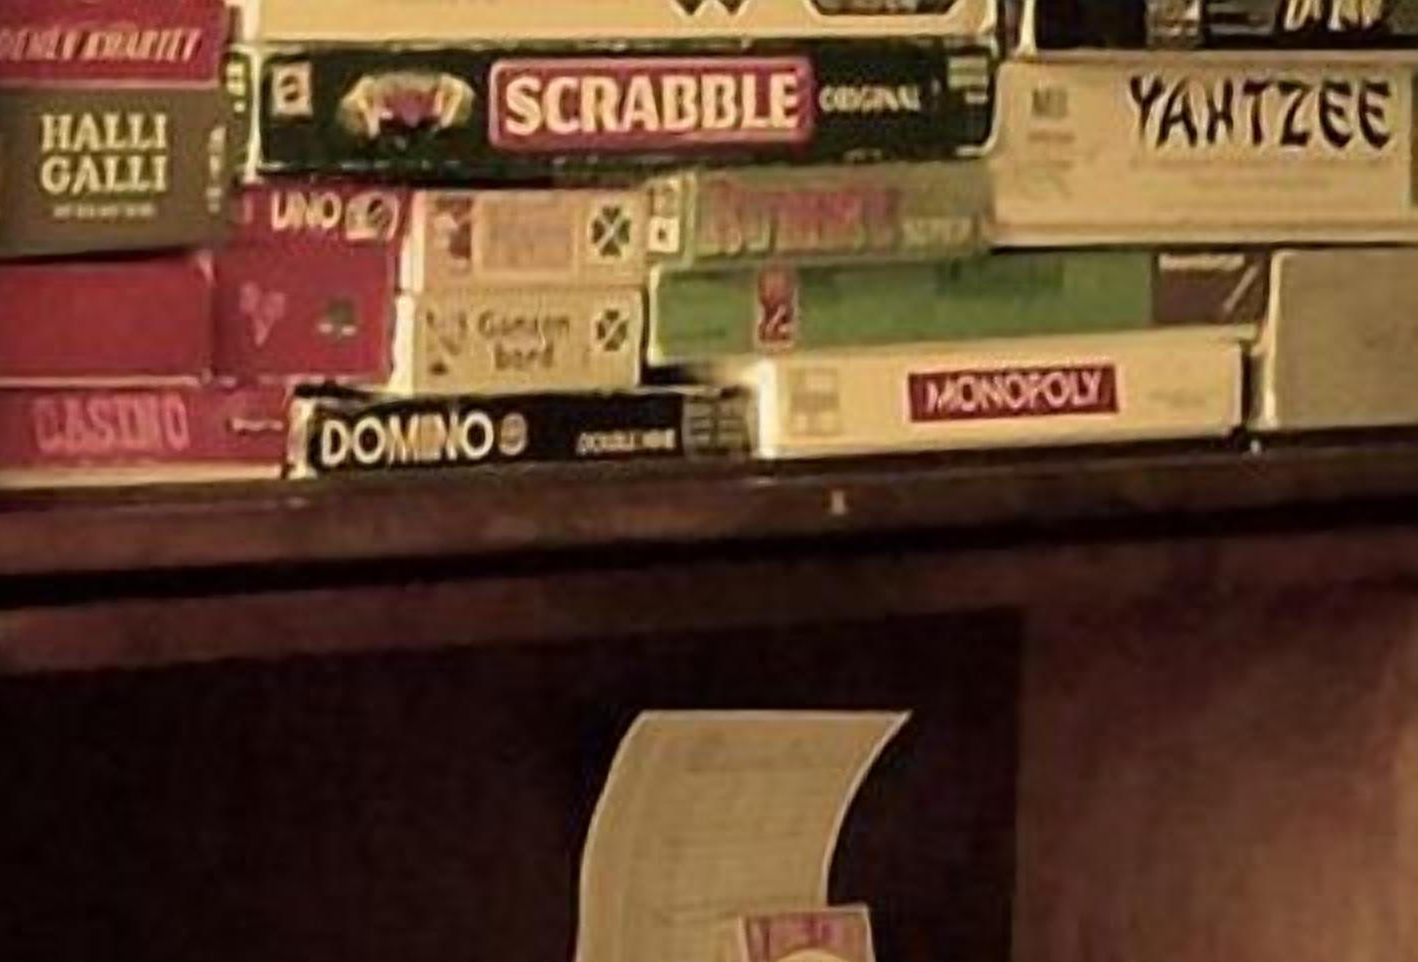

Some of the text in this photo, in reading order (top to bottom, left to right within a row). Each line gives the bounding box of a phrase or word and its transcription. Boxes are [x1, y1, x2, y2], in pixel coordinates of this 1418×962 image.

[504, 71, 799, 135] SCRABBLE
[1129, 75, 1392, 149] YAHTZEE
[41, 113, 168, 152] HALLI
[40, 155, 168, 194] GALLI
[270, 192, 342, 230] UNO
[925, 369, 1104, 414] MONOPOLY
[34, 394, 190, 455] CASINO
[321, 403, 494, 467] DOMINO
